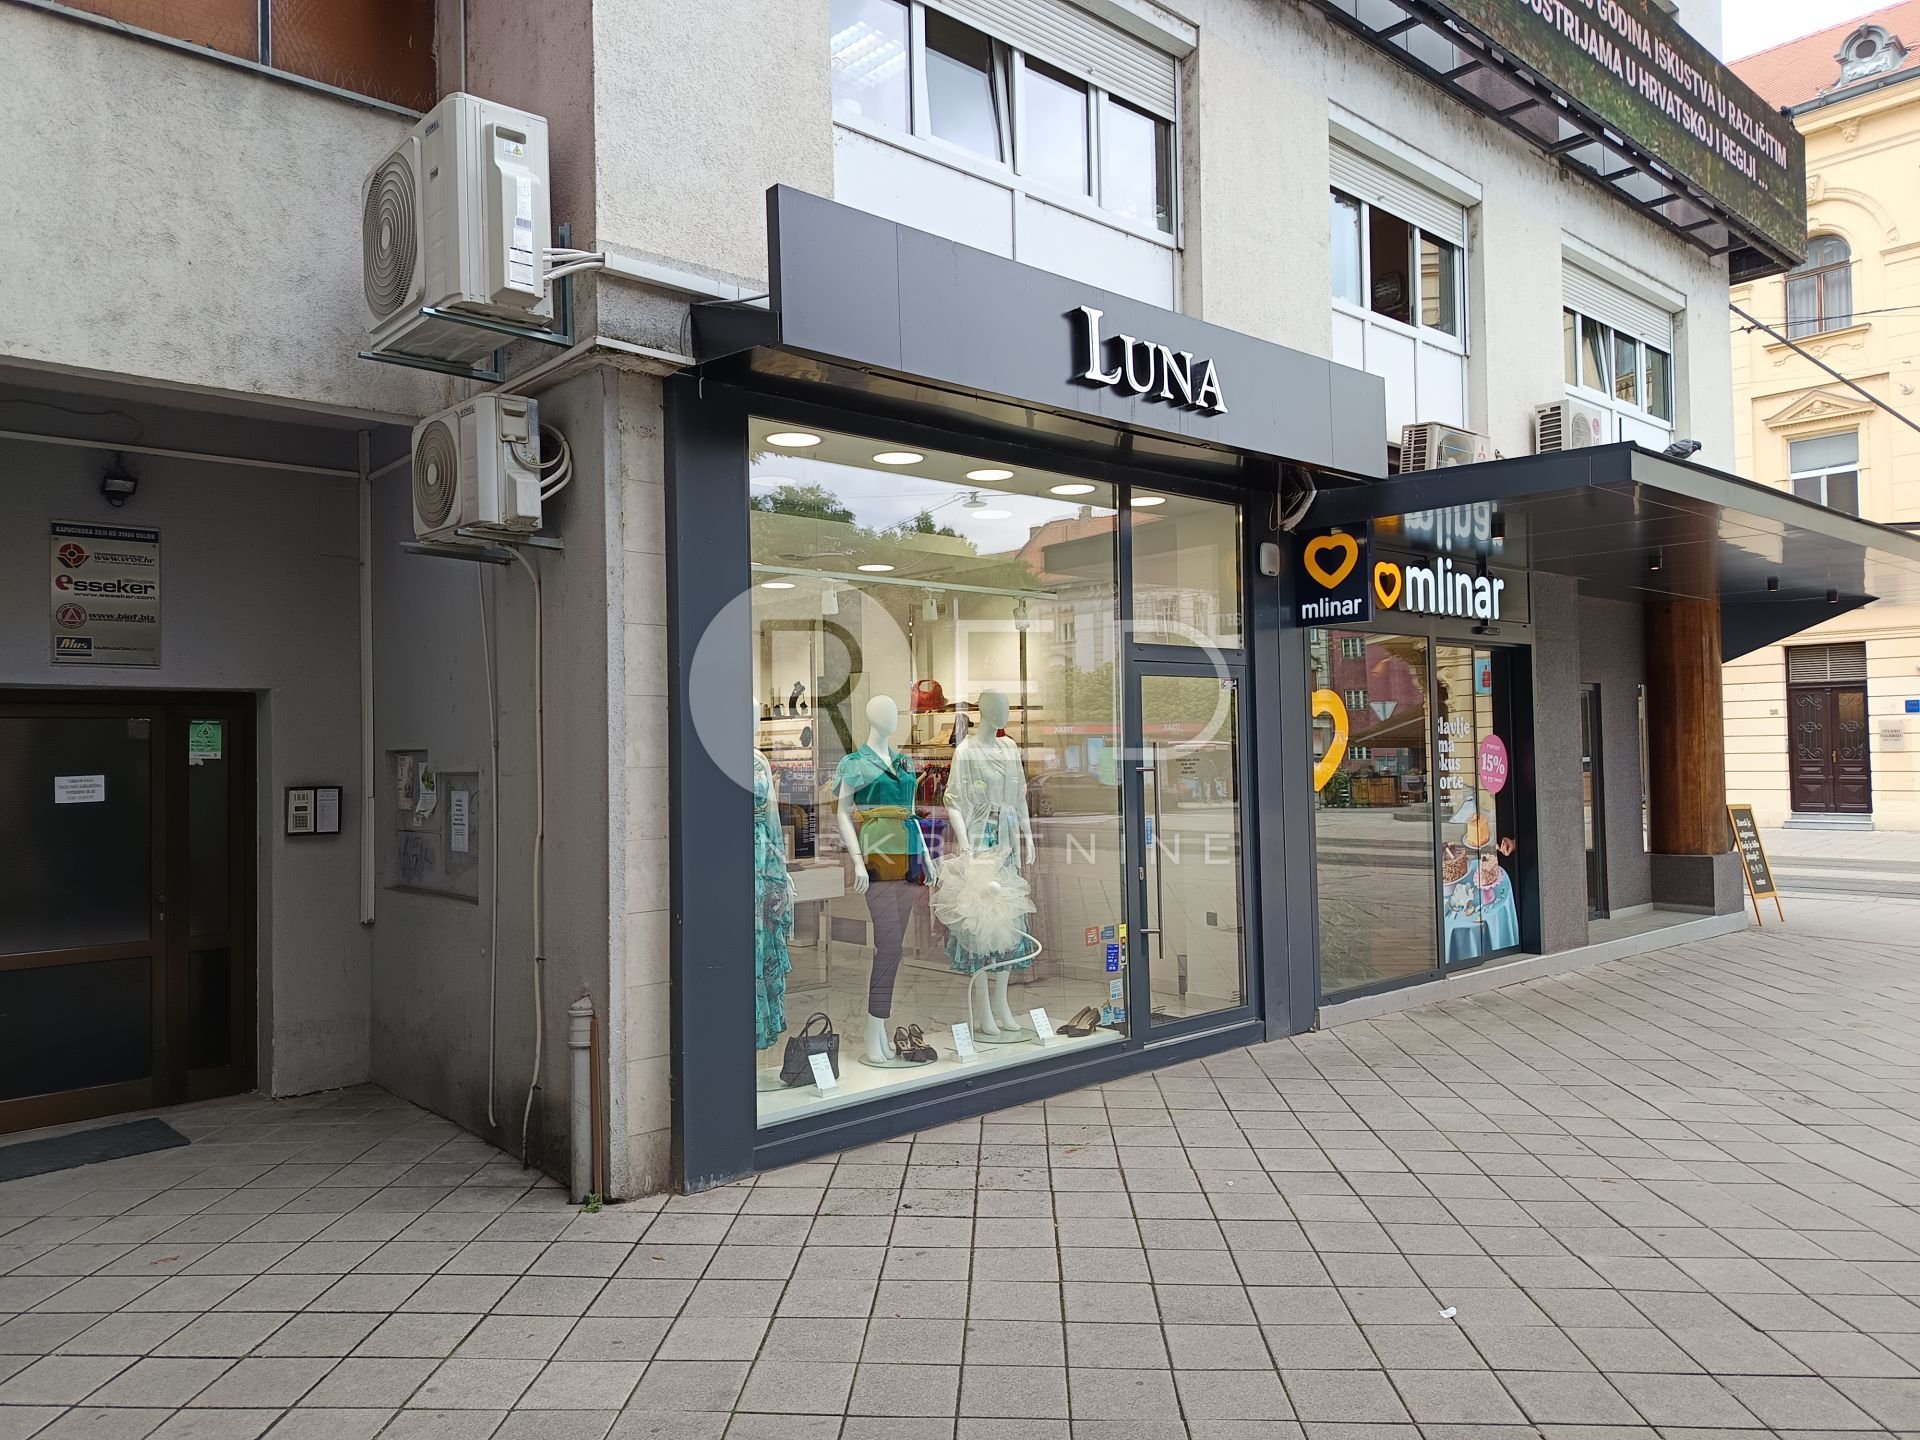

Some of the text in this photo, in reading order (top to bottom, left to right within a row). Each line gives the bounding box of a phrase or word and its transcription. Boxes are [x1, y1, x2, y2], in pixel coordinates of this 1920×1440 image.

[1524, 0, 1623, 80] USTRIJAMA
[1626, 56, 1636, 88] U
[1639, 67, 1714, 148] HRVATSKOJ
[1715, 128, 1720, 153] I
[1722, 132, 1757, 181] REGIJI
[1596, 0, 1787, 170] GODINA ISKUSTVA U RAZLIČITIM
[1080, 305, 1229, 413] LUNA
[55, 574, 156, 595] esseker
[1405, 557, 1505, 620] mlinar
[1301, 597, 1363, 620] mlinar
[1438, 739, 1455, 753] ma
[1481, 752, 1505, 775] 15%
[1439, 774, 1464, 790] orte
